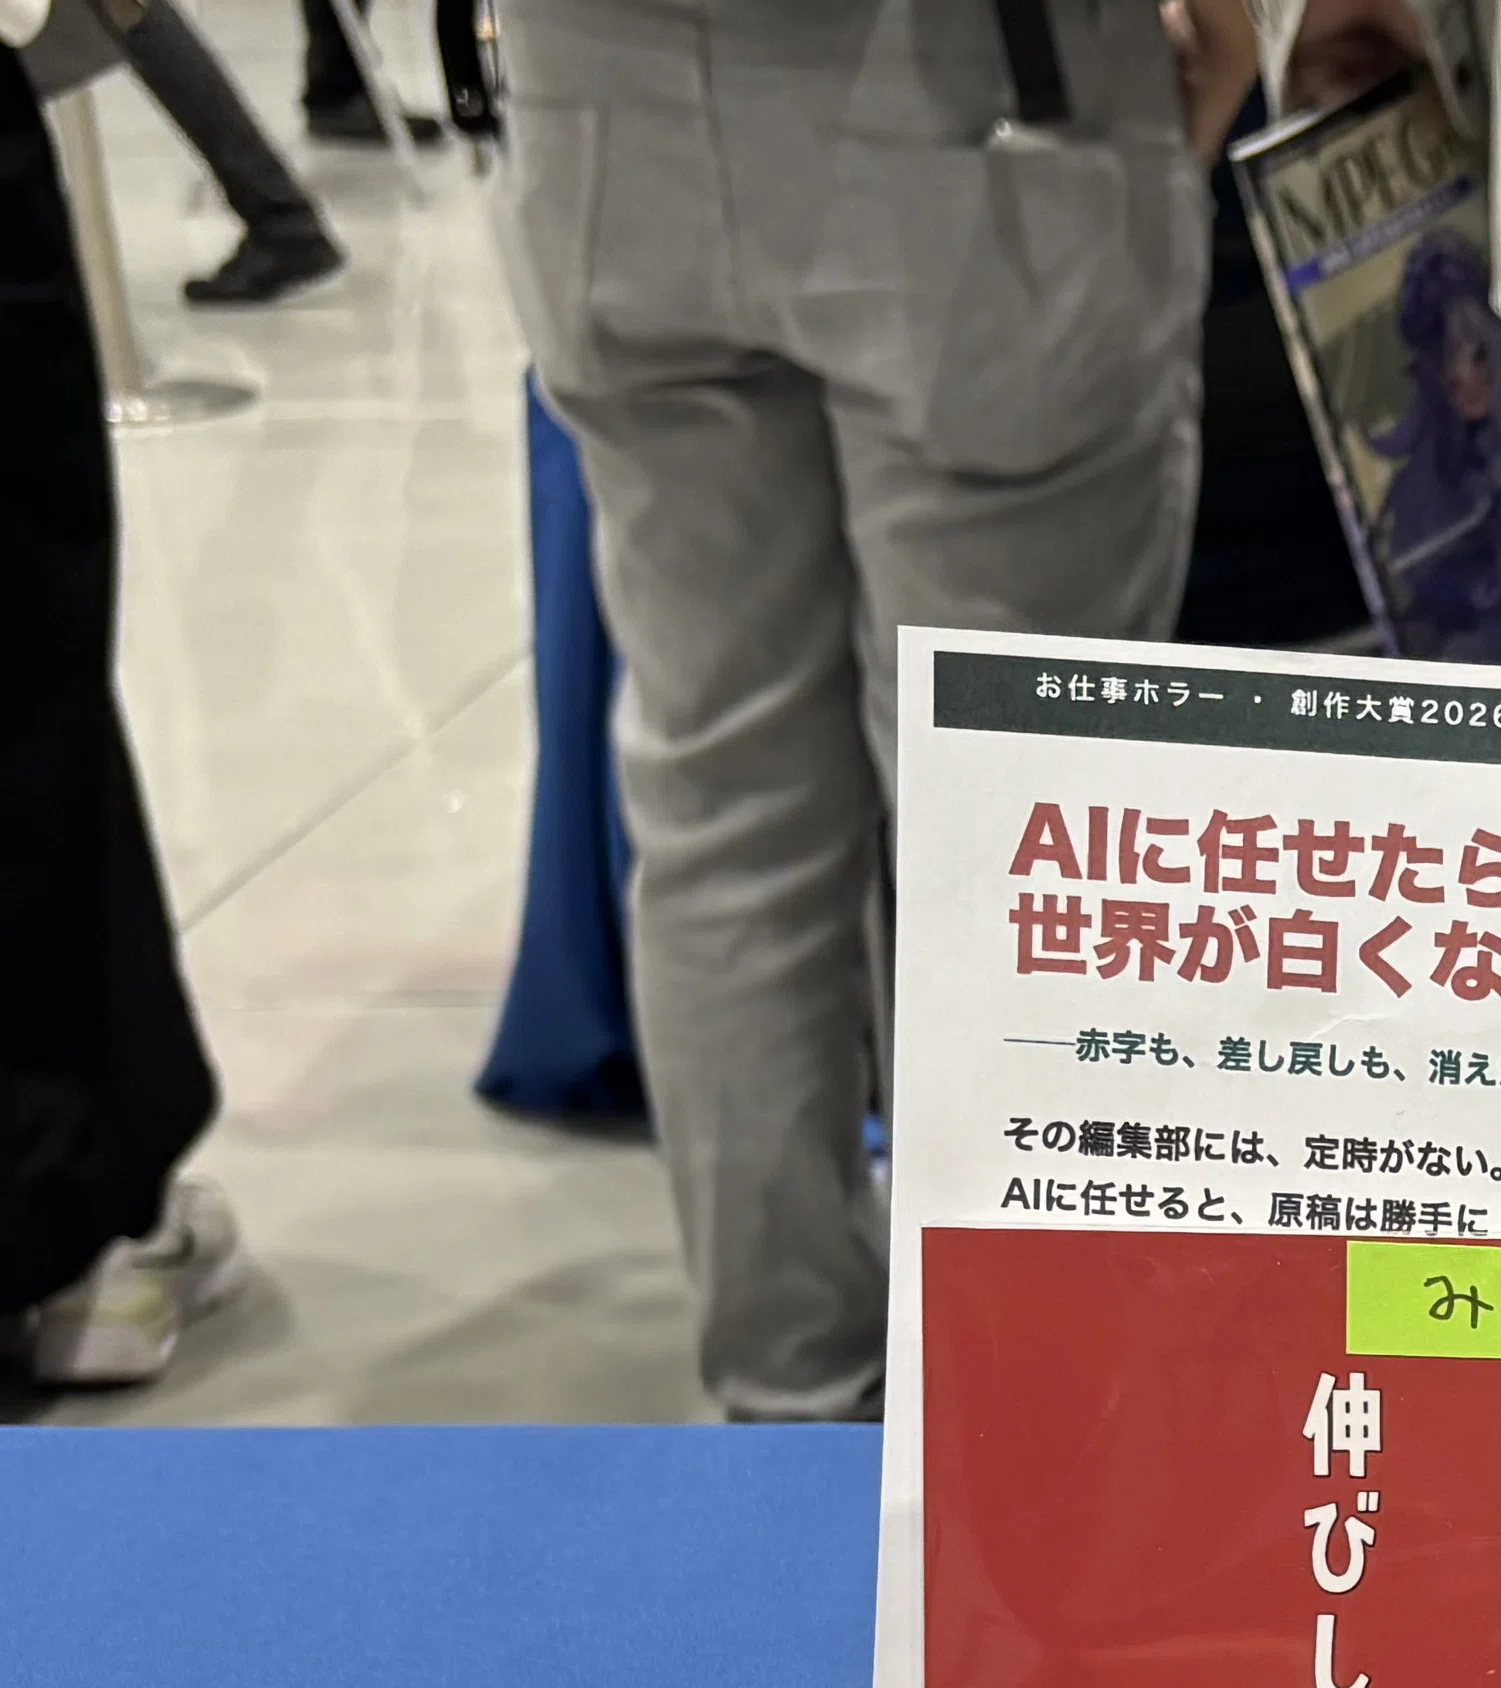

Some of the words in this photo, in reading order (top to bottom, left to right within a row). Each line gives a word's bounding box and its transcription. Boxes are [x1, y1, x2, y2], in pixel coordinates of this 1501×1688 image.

[1037, 672, 1223, 706] お仕事ホラー
